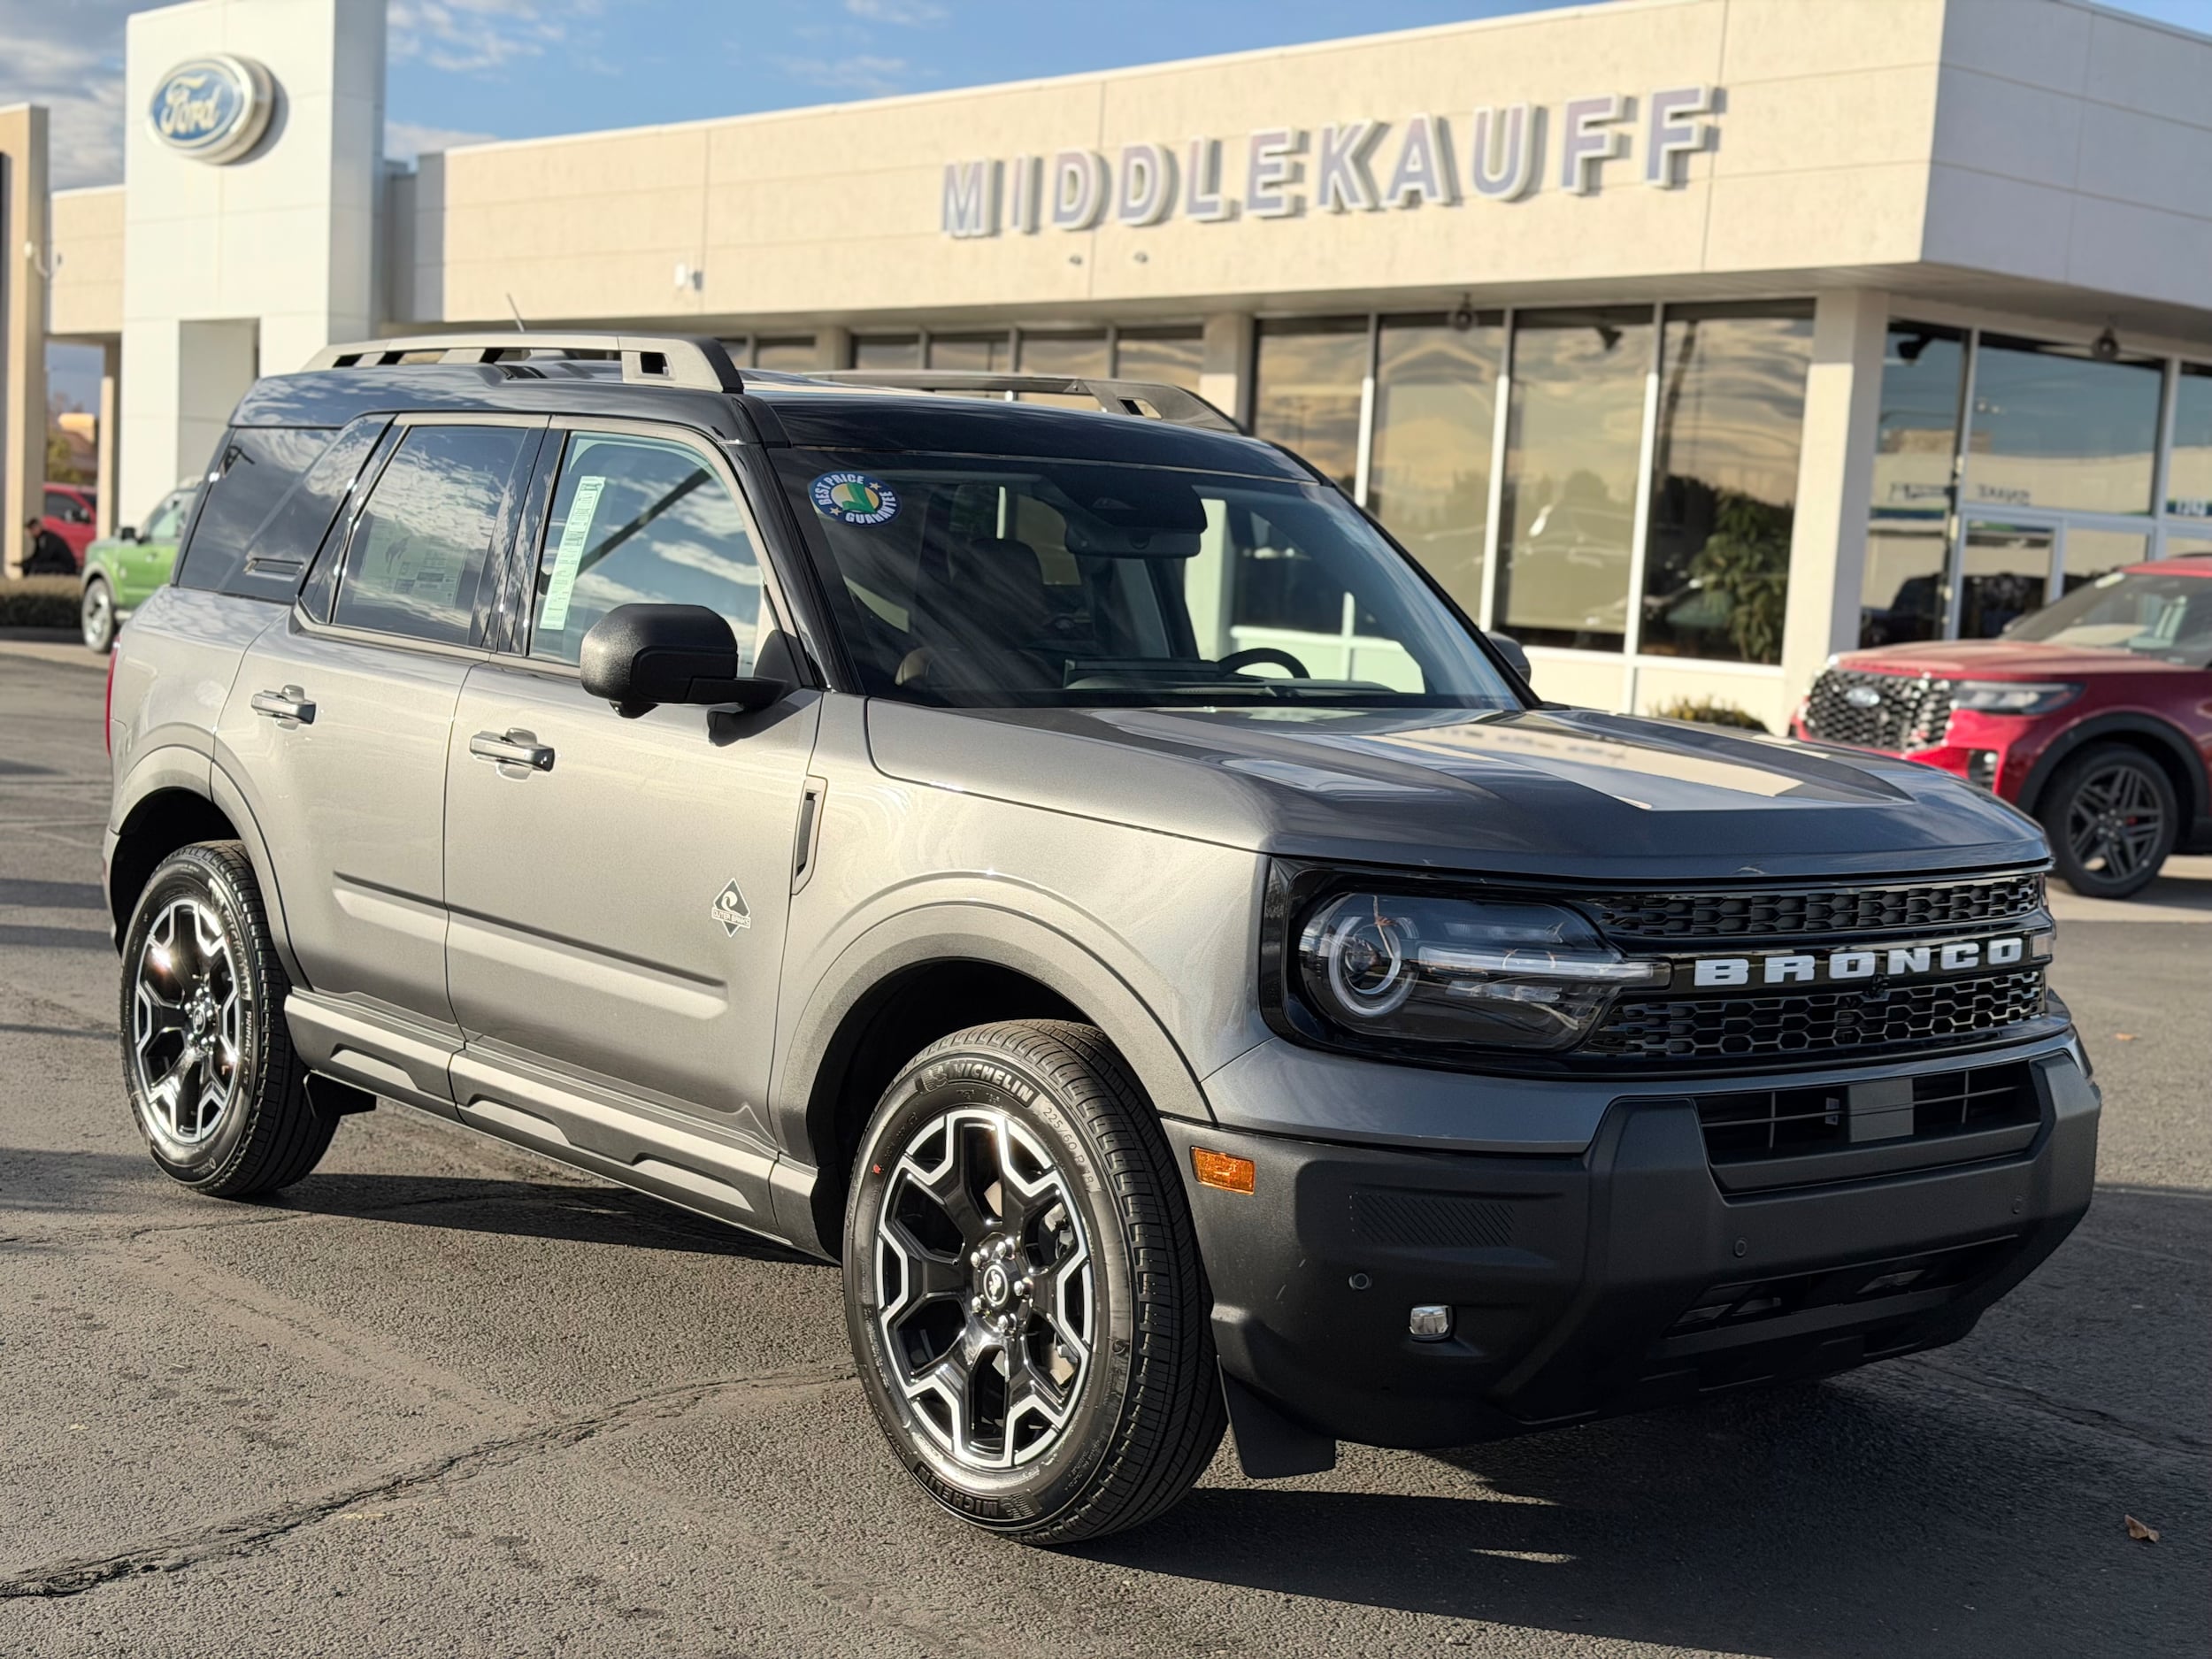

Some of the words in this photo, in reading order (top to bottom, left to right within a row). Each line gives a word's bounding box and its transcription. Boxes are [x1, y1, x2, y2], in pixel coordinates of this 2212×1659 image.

[160, 73, 221, 135] Ford
[941, 85, 1722, 238] MIDDLEKAUFF
[814, 482, 833, 506] BEST
[823, 473, 864, 486] PRICE
[846, 490, 897, 525] GUARANTEE
[713, 910, 731, 921] OUTER
[1694, 938, 2023, 987] BRONCO
[949, 1063, 1033, 1103] MICHELIN
[1042, 1107, 1078, 1150] 225/60
[916, 1464, 999, 1517] MICHELIN
